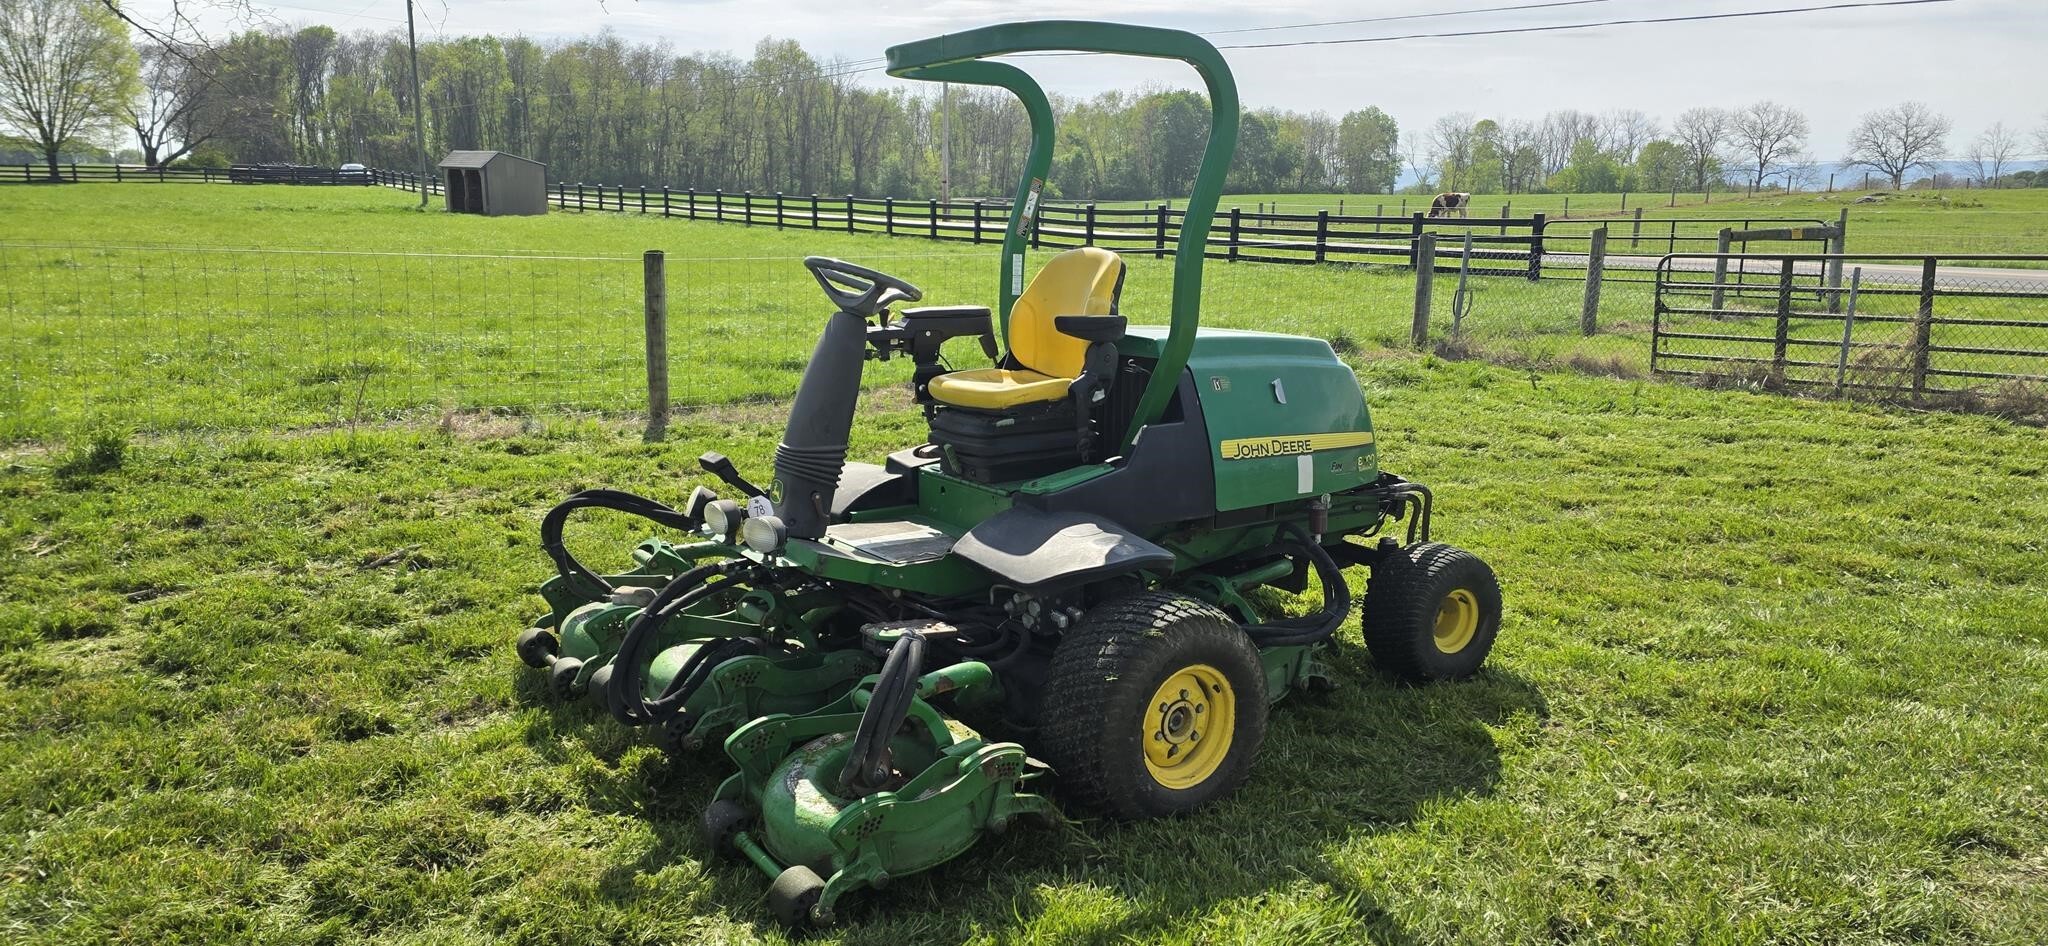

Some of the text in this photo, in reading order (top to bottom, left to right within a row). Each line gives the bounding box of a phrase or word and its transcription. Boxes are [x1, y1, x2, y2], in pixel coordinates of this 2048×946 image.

[1234, 440, 1312, 458] JOHN DEERE
[754, 504, 766, 516] 78
